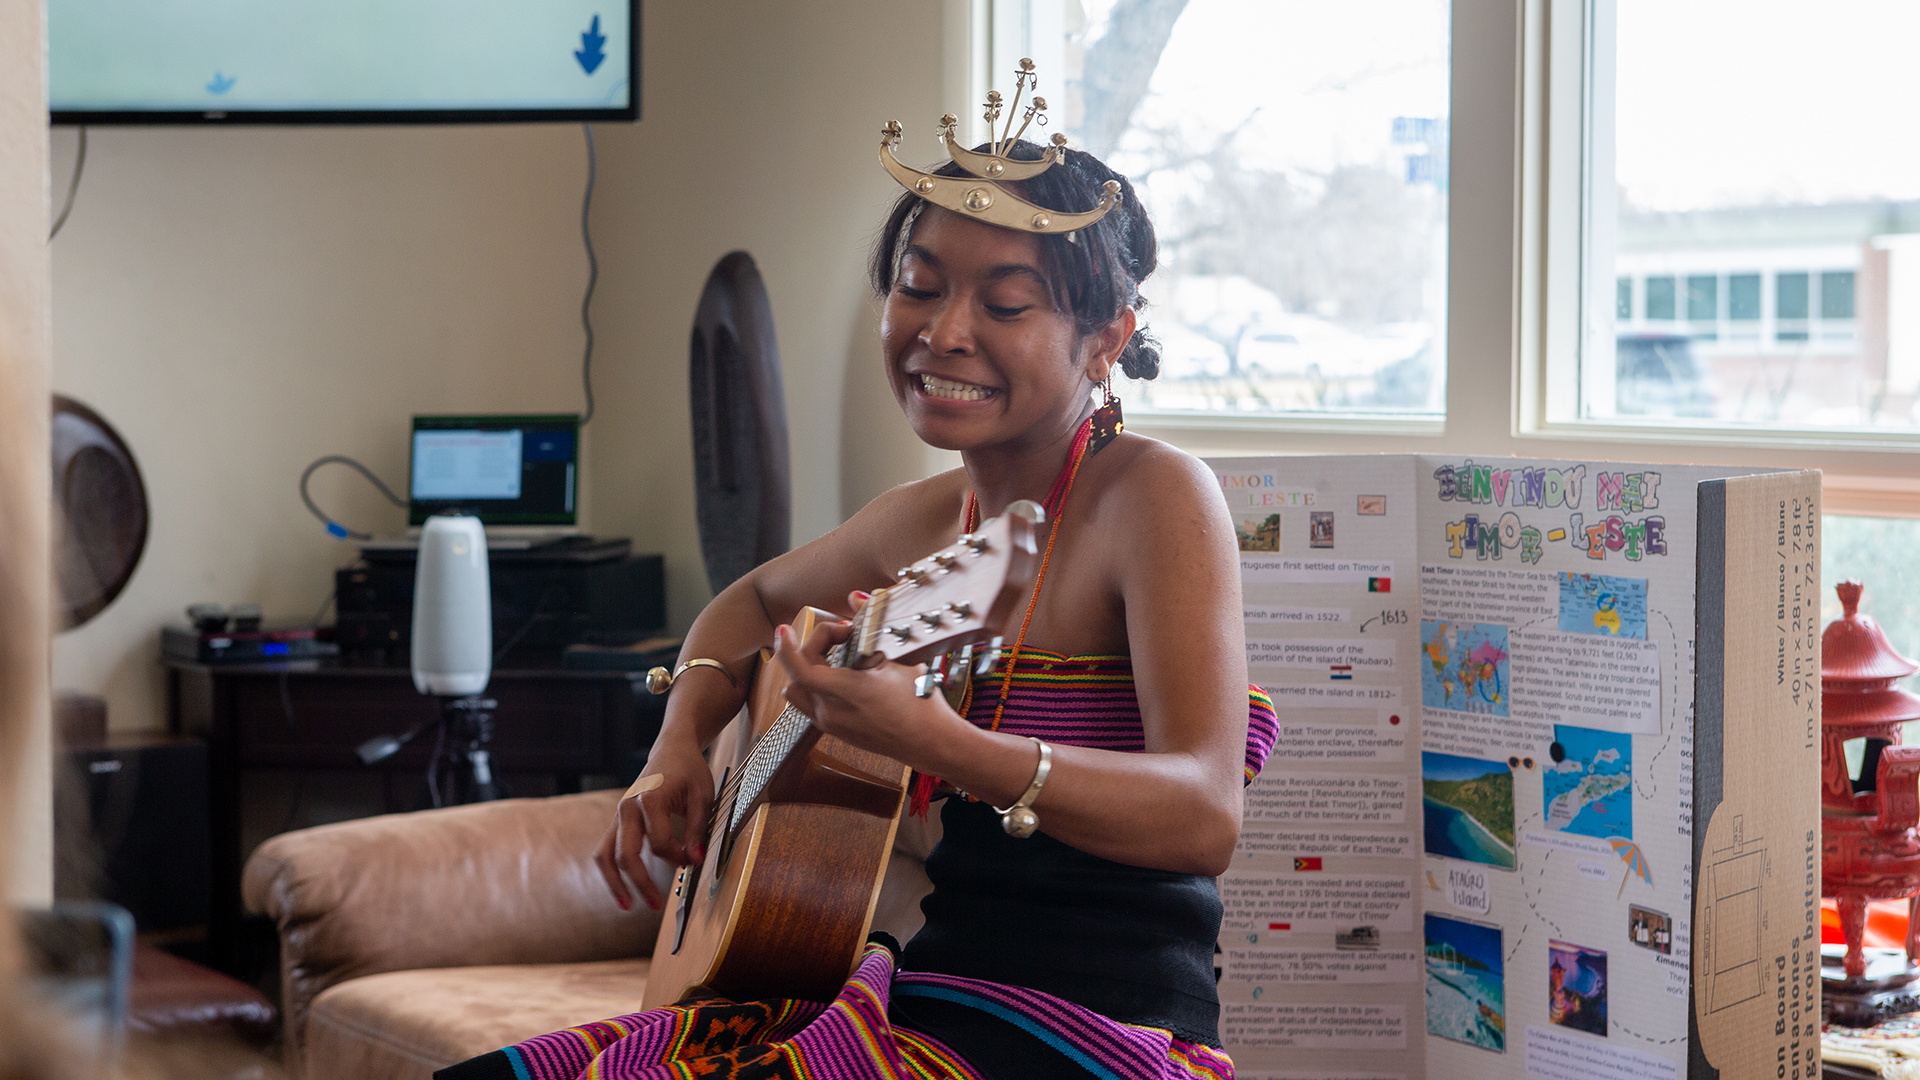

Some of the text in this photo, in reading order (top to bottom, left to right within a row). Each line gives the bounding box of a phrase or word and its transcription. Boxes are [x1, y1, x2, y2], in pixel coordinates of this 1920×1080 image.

[1216, 474, 1275, 488] IMOR
[1249, 492, 1315, 506] LESTE
[1446, 512, 1543, 565] TIMOR
[1570, 512, 1668, 562] LESTE
[1240, 562, 1280, 570] rtuguese
[1283, 562, 1301, 570] first
[1805, 542, 1814, 586] 72.3
[1380, 609, 1408, 625] 1613
[1807, 618, 1813, 649] cm
[1336, 645, 1346, 653] of
[1569, 636, 1587, 644] Timor
[1643, 641, 1657, 650] with
[1795, 638, 1800, 651] x
[1522, 644, 1554, 652] mountains
[1555, 647, 1572, 656] rising
[1601, 650, 1614, 659] feet
[1286, 654, 1295, 662] of
[1315, 656, 1342, 665] island
[1264, 686, 1306, 694] overned
[1283, 727, 1303, 736] East
[1306, 727, 1332, 735] Timor
[1273, 748, 1324, 758] Portuguese
[1358, 779, 1370, 788] do
[1381, 790, 1405, 799] Front
[1309, 799, 1328, 808] East
[1372, 802, 1403, 810] gained
[1252, 810, 1263, 818] of
[1292, 810, 1302, 819] of
[1322, 812, 1360, 820] territory
[1362, 810, 1380, 820] and
[1277, 833, 1316, 841] declared
[1332, 834, 1395, 843] independence
[1245, 842, 1297, 851] Democratic
[1299, 843, 1338, 852] Republic
[1340, 844, 1350, 853] of
[1352, 845, 1372, 853] East
[1375, 845, 1403, 854] Timor.
[1275, 878, 1304, 887] forces
[1803, 830, 1813, 941] battants
[1267, 889, 1285, 897] and
[1299, 889, 1322, 898] 1976
[1324, 890, 1369, 898] Indonesia
[1371, 891, 1410, 899] declared
[1453, 890, 1486, 909] Island
[1244, 899, 1256, 908] be
[1272, 900, 1307, 909] integral
[1331, 900, 1341, 909] of
[1343, 901, 1362, 909] that
[1364, 902, 1400, 910] country
[1224, 909, 1234, 917] as
[1295, 910, 1305, 919] of
[1307, 910, 1327, 919] East
[1330, 911, 1356, 919] Timor
[1359, 911, 1390, 921] (Timor
[1655, 954, 1689, 971] Ximenes
[1804, 950, 1813, 1014] trois
[1666, 986, 1683, 996] work
[1790, 936, 1799, 1080] entaciones
[1775, 955, 1785, 1079] on Board
[1806, 1048, 1816, 1079] ge
